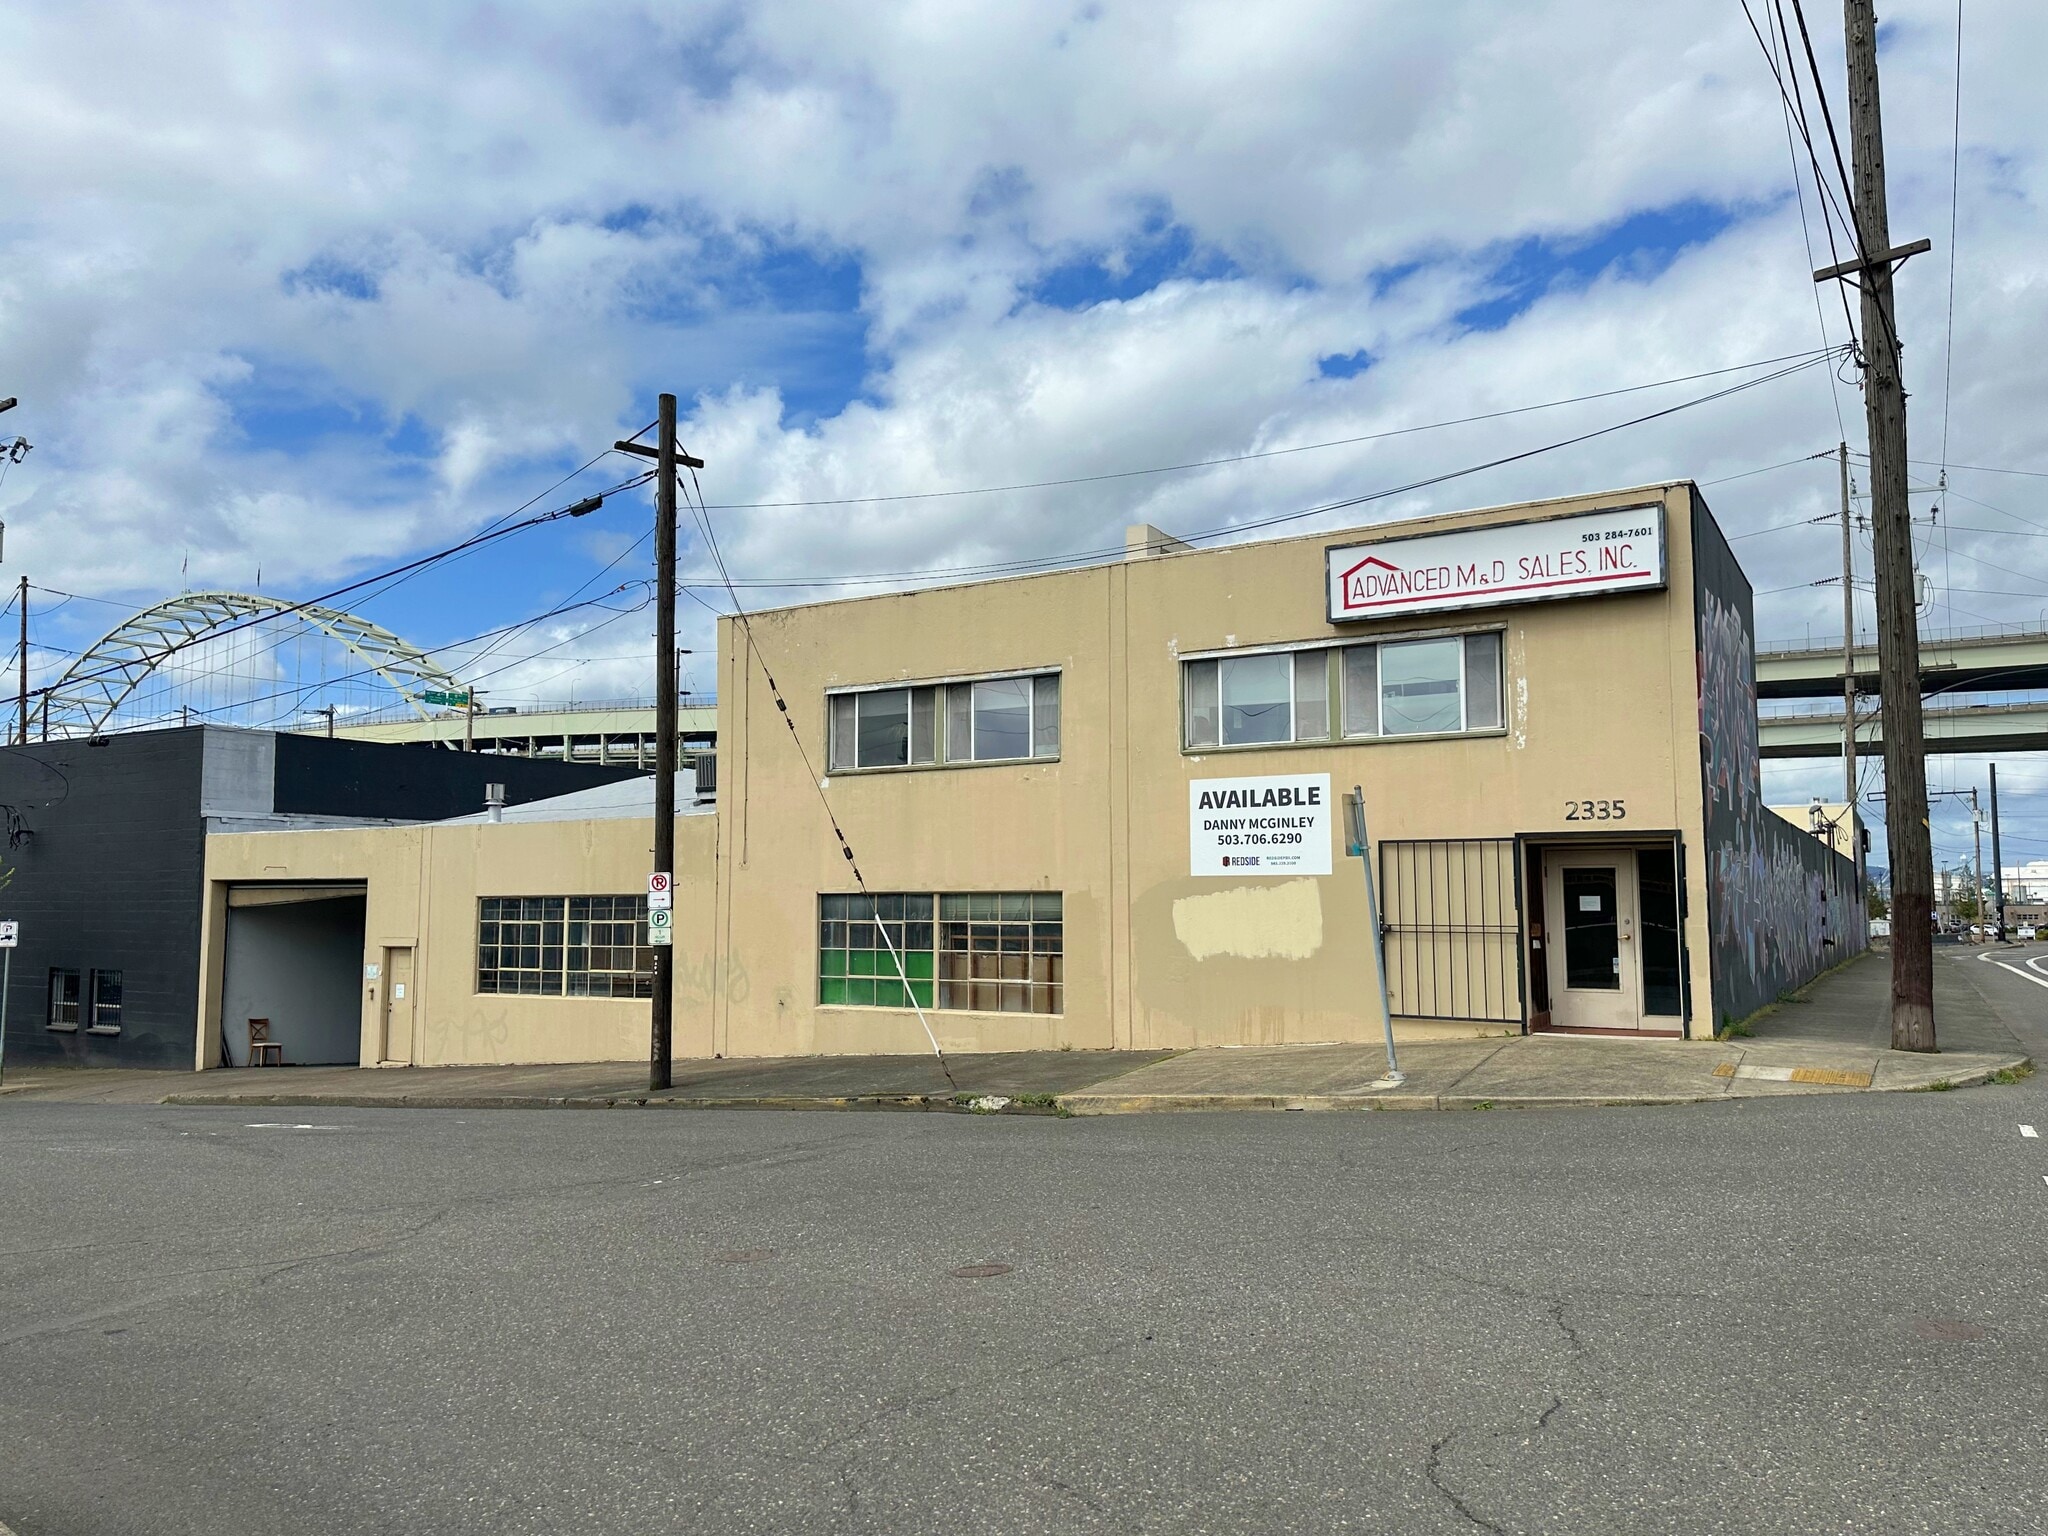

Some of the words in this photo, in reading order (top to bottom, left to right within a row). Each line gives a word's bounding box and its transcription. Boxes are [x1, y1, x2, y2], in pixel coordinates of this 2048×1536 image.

[1582, 532, 1600, 542] 503
[1605, 527, 1652, 540] 284-7601
[1352, 566, 1450, 600] ADVANCED
[1599, 544, 1637, 571] INC.
[1198, 786, 1321, 810] AVAILABLE
[1565, 799, 1626, 821] 2335
[1203, 818, 1246, 831] DANNY
[1249, 816, 1315, 830] MCGINLEY
[1217, 832, 1302, 846] 503.706.6290
[1231, 856, 1260, 867] REDSIDE
[656, 913, 665, 924] P
